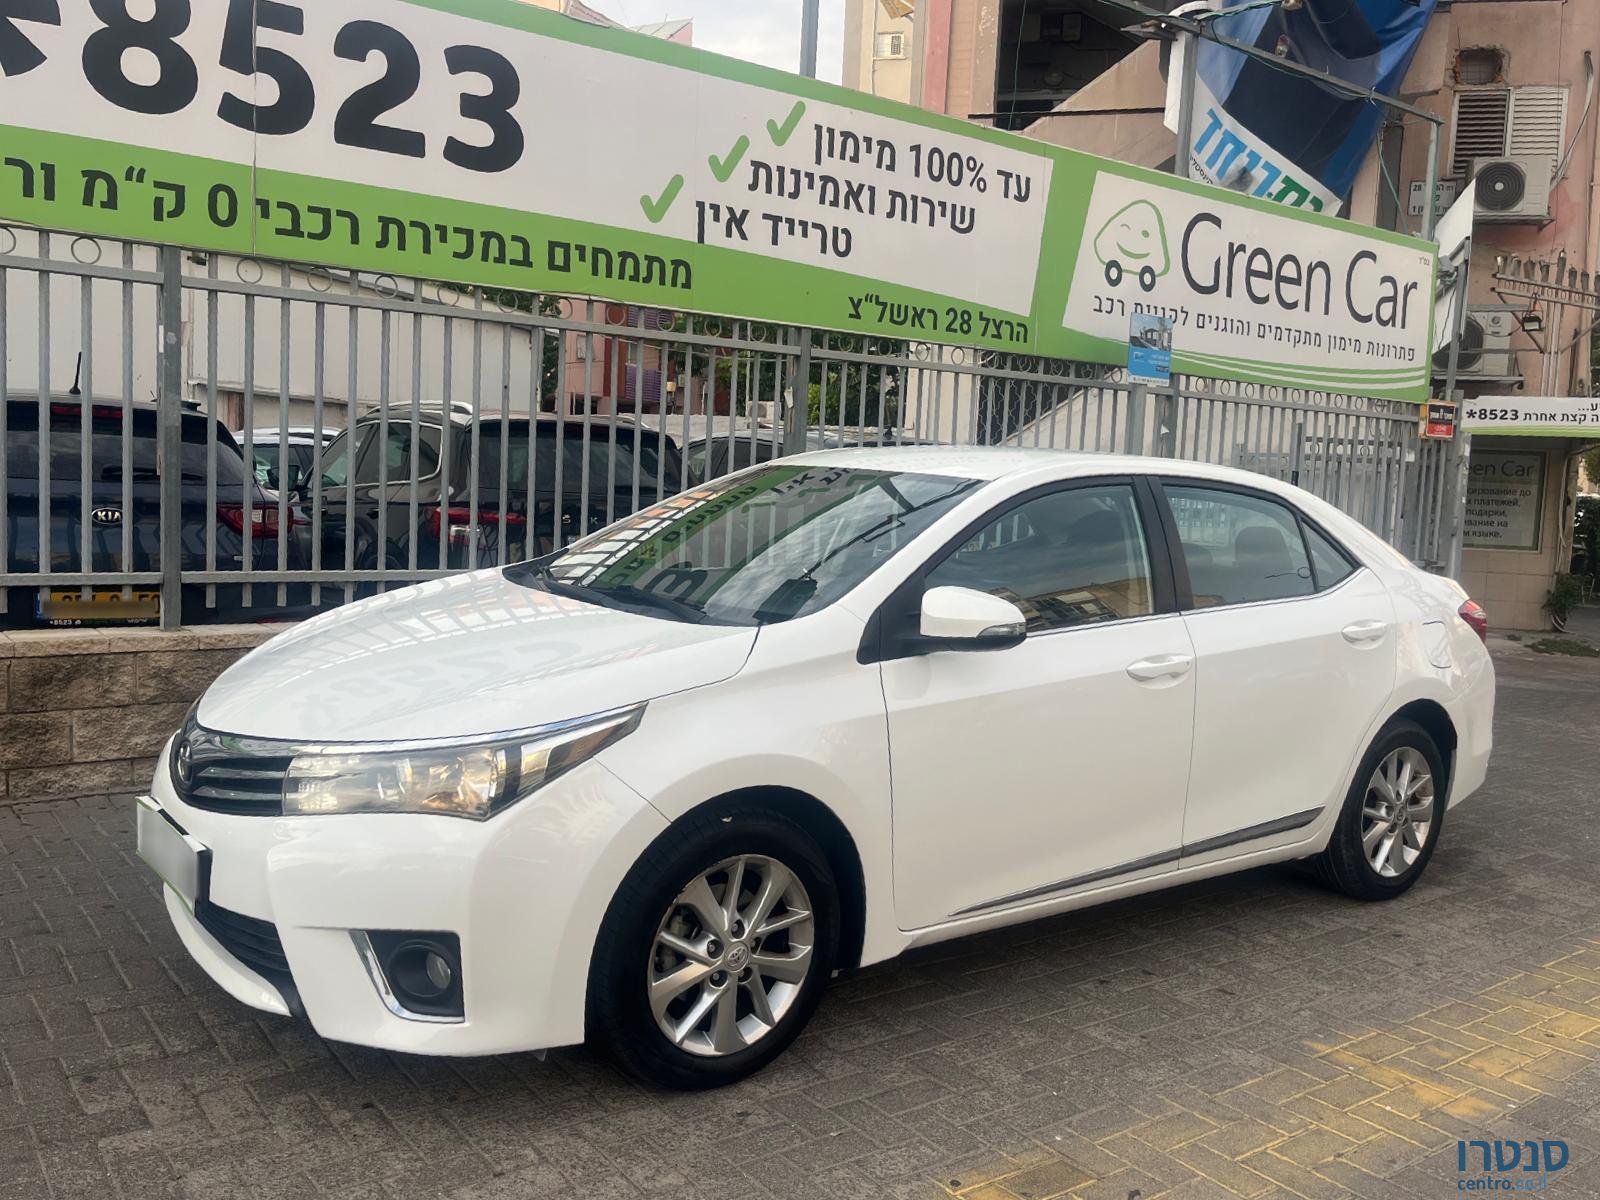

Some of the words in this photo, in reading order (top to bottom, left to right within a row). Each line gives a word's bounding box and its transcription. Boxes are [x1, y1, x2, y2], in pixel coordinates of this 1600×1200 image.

[814, 123, 897, 172] מימון
[908, 143, 988, 193] 100%
[747, 159, 876, 216] ואמינות
[996, 169, 1032, 202] עד
[207, 183, 239, 228] 0
[255, 197, 361, 246] רכבי
[695, 200, 750, 244] אין
[885, 189, 976, 234] שירות
[376, 213, 533, 268] במכירת
[761, 212, 853, 258] טרייד
[547, 238, 693, 290] מתמחים
[1181, 212, 1332, 316] Green
[1345, 249, 1418, 330] Car
[945, 307, 972, 335] 28
[1093, 295, 1125, 316] רכב
[978, 311, 1028, 343] הרצל
[1196, 313, 1250, 336] והוגנים
[1257, 322, 1322, 349] מתקדמים
[1327, 334, 1361, 354] מימון
[1366, 340, 1415, 361] פתרונות
[1523, 412, 1556, 422] אחרת
[1560, 413, 1587, 424] קצת
[1501, 460, 1535, 477] Car
[97, 511, 121, 520] KIA
